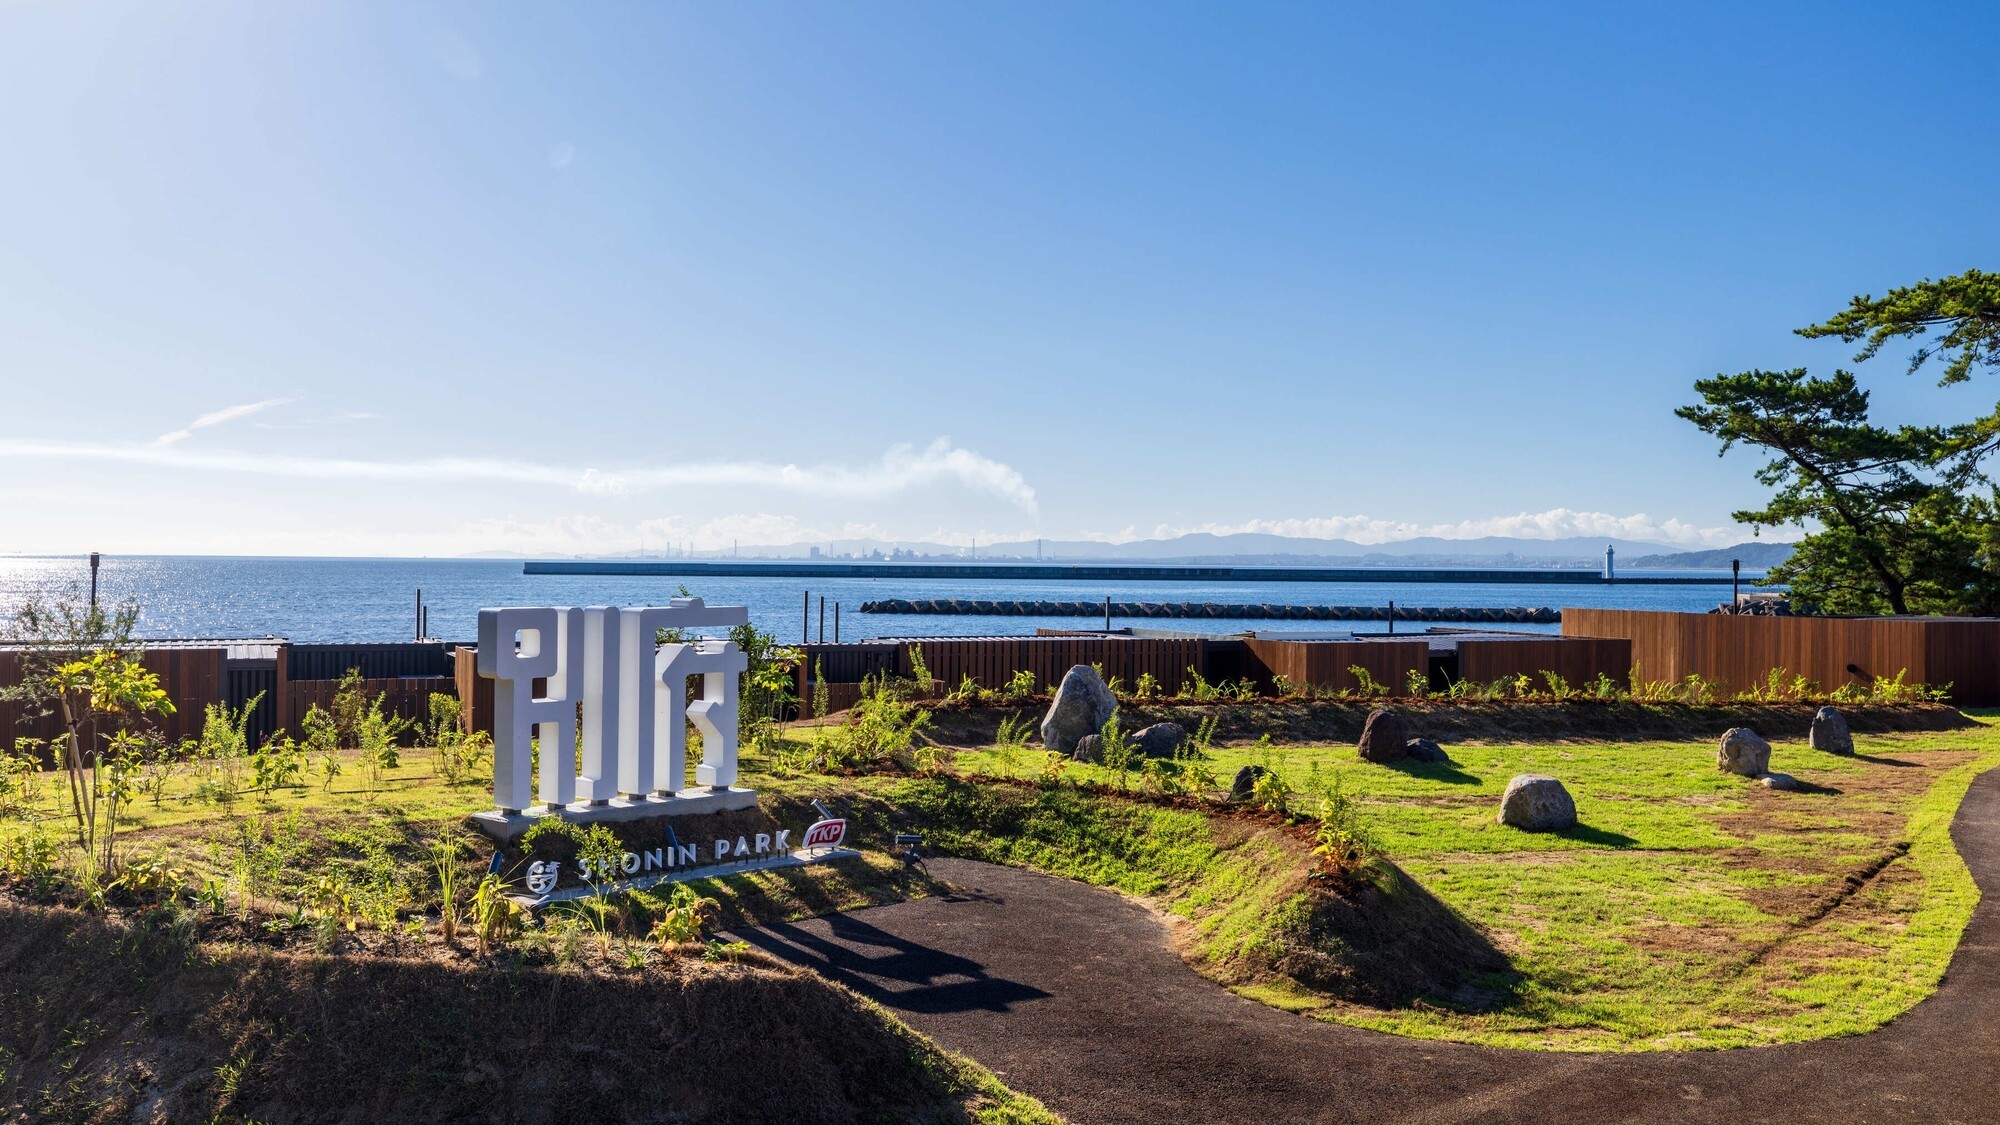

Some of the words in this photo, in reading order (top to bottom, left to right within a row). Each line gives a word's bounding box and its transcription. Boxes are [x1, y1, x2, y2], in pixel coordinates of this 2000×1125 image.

[811, 824, 842, 843] TKP
[578, 843, 697, 881] SHONIN
[715, 829, 790, 860] PARK
